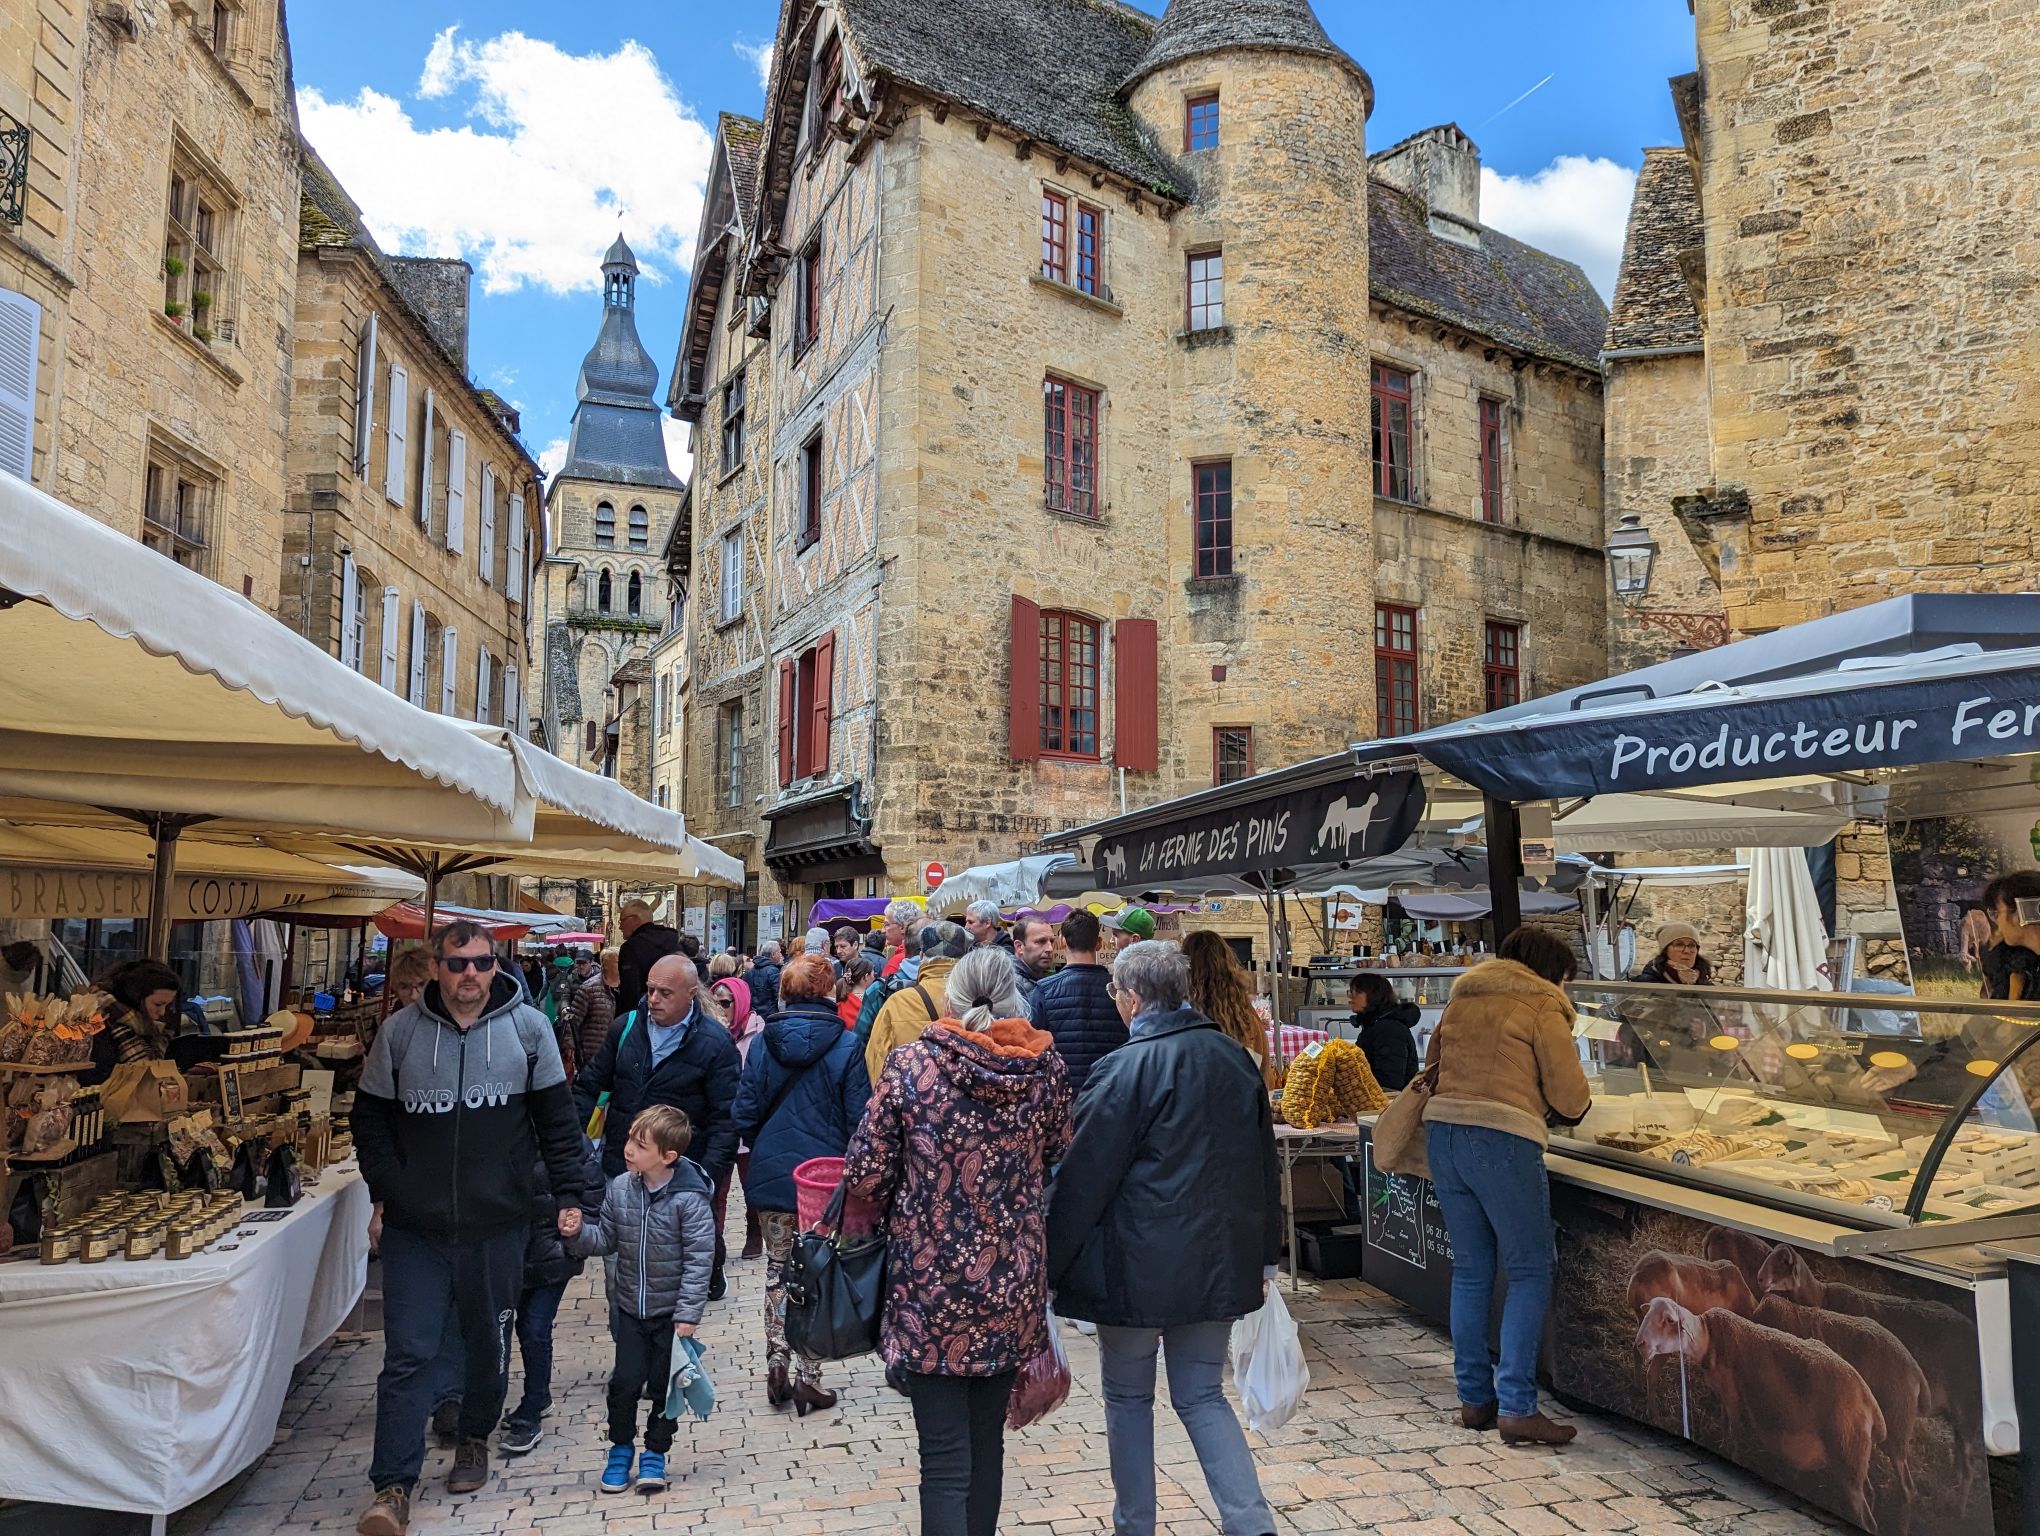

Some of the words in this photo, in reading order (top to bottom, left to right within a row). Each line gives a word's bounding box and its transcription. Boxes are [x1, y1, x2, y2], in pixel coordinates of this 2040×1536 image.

[1609, 718, 1918, 780] Producteur
[1951, 696, 2040, 745] Fer
[1139, 841, 1155, 872] LA
[1157, 830, 1206, 871] FERME
[1206, 820, 1241, 862] DES
[1245, 810, 1291, 859] PINS
[10, 870, 142, 914] BRASSER
[188, 878, 260, 915] COSTA
[1425, 1223, 1434, 1236] 06
[1435, 1227, 1442, 1239] 21
[1427, 1239, 1435, 1251] 05
[1436, 1243, 1445, 1256] 55
